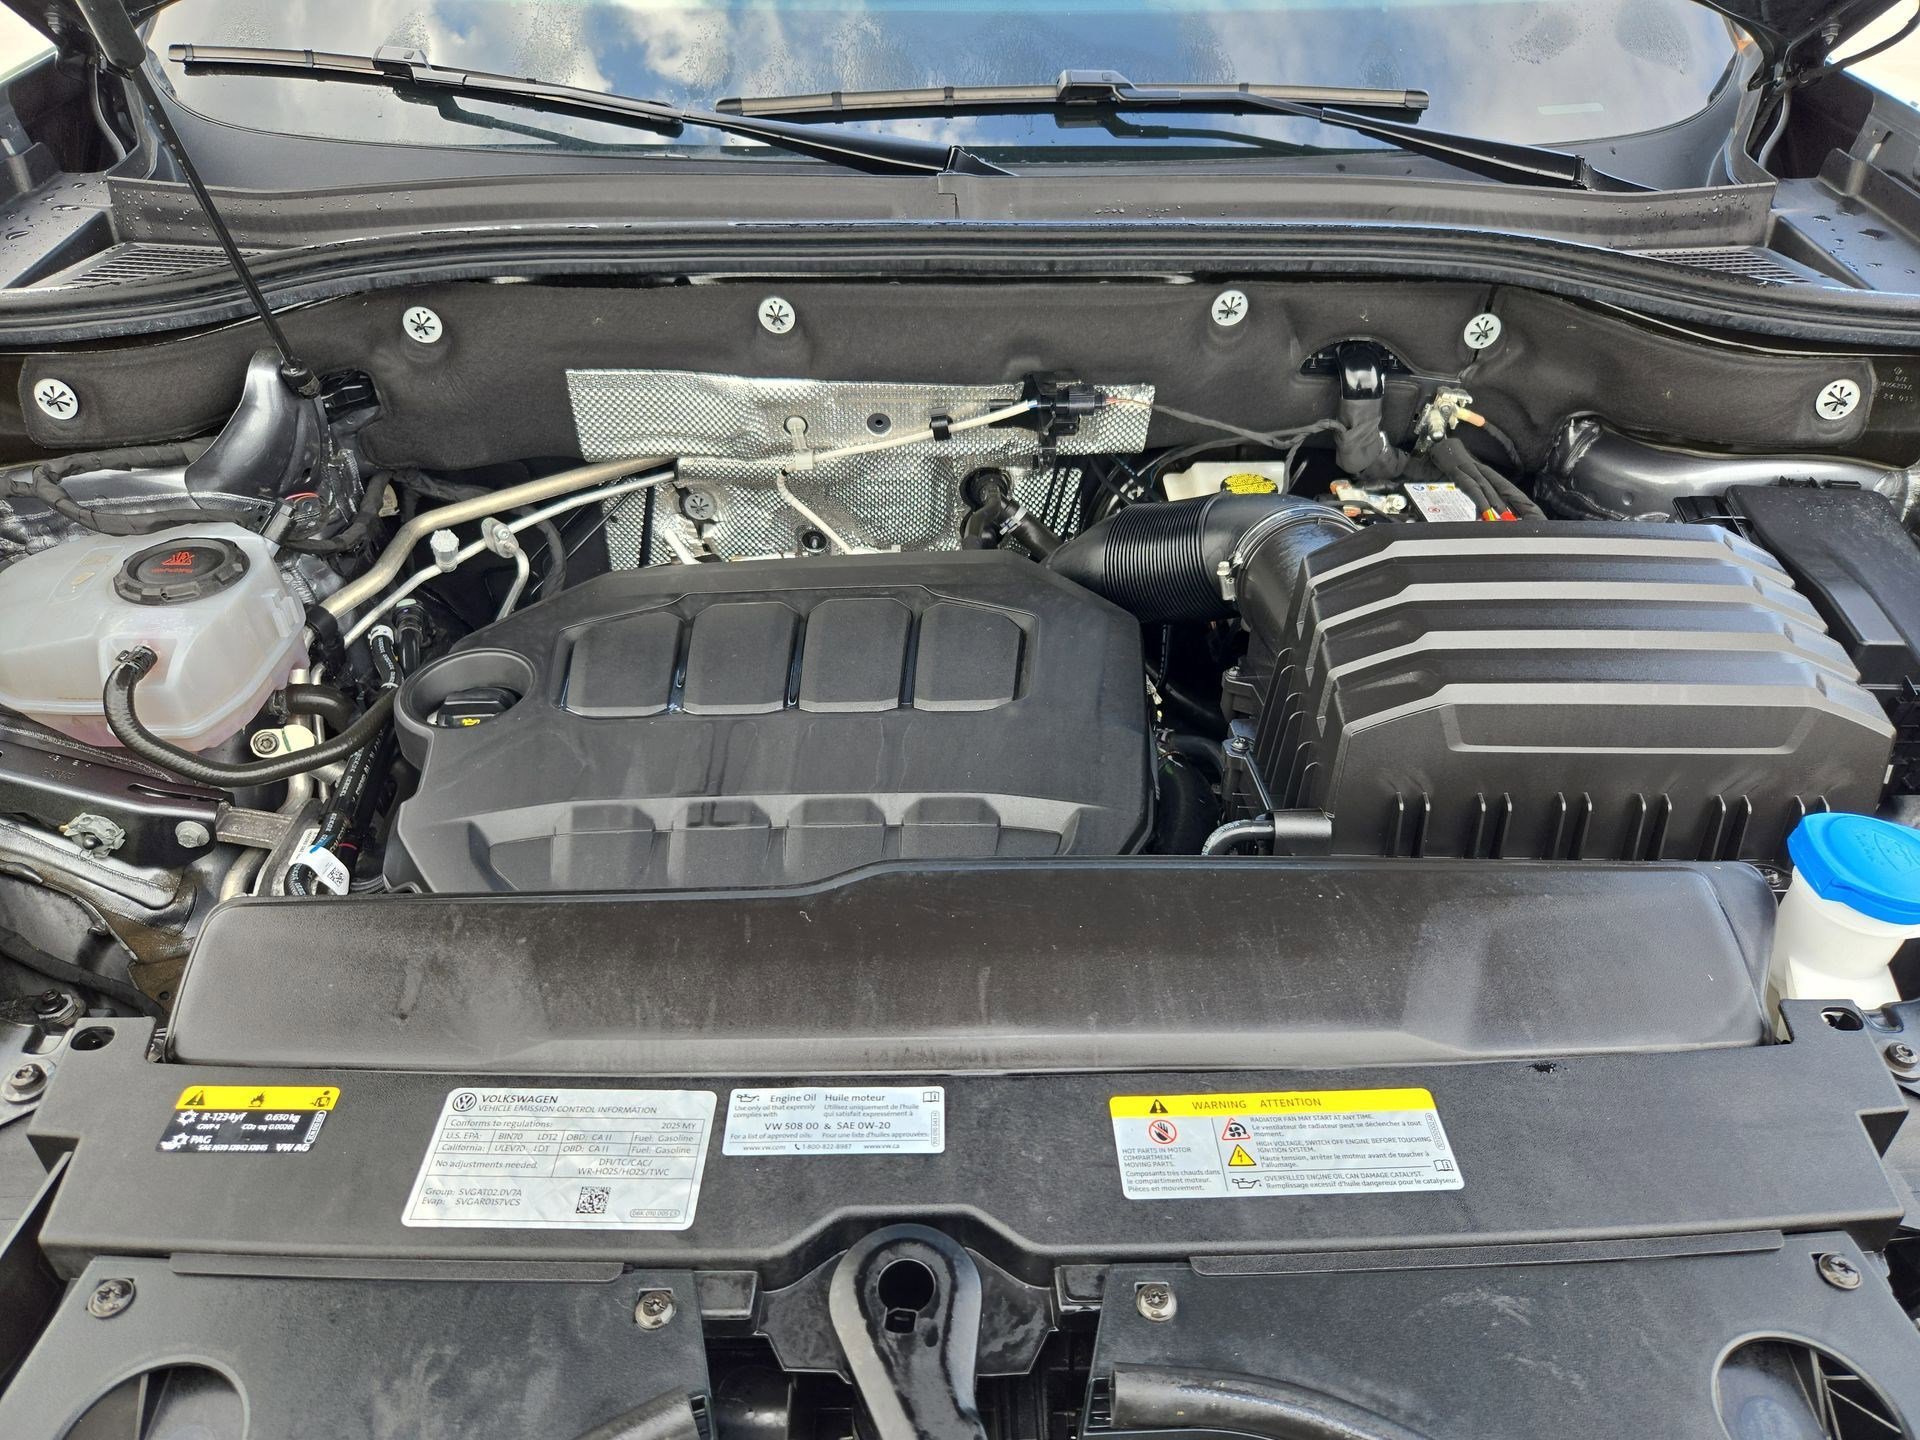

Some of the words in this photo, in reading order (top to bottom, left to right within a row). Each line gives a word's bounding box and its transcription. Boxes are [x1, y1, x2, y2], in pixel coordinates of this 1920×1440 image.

[482, 1094, 558, 1104] VOLKSWAGEN
[770, 1094, 801, 1104] Engine
[804, 1093, 817, 1101] Oil
[825, 1094, 850, 1102] Huile
[851, 1094, 886, 1102] moteur
[786, 1104, 816, 1112] expressly
[1192, 1099, 1247, 1110] WARNING
[1260, 1098, 1322, 1108] ATTENTION
[478, 1104, 511, 1112] VEHICLE
[513, 1104, 555, 1112] EMISSION
[556, 1105, 596, 1113] CONTROL
[597, 1105, 658, 1114] INFORMATION
[201, 1112, 248, 1123] R-1234yf
[289, 1113, 301, 1123] kg
[733, 1111, 762, 1119] complies
[451, 1120, 490, 1128] Conforms
[503, 1120, 553, 1129] regulations:
[661, 1122, 681, 1130] 2025
[682, 1122, 697, 1130] MY
[764, 1122, 783, 1131] VW
[784, 1122, 803, 1130] 508
[805, 1122, 819, 1130] 00
[836, 1122, 856, 1130] SAE
[857, 1121, 892, 1130] 0W-20
[189, 1135, 213, 1144] PAG
[446, 1132, 462, 1140] U.S.
[498, 1132, 524, 1140] BIN70
[537, 1133, 558, 1141] LDT2
[566, 1133, 588, 1141] OBD:
[634, 1134, 653, 1142] Fuel:
[657, 1134, 694, 1142] Gasoline
[767, 1133, 799, 1141] approved
[276, 1143, 294, 1152] VW
[293, 1143, 310, 1152] AG
[441, 1143, 486, 1152] California:
[494, 1144, 526, 1152] ULEV70
[533, 1145, 550, 1153] LDT
[562, 1145, 584, 1153] OBD:
[588, 1145, 601, 1153] CA
[631, 1146, 651, 1154] Fuel:
[655, 1146, 692, 1154] Gasoline
[435, 1160, 448, 1168] No
[449, 1160, 503, 1169] adjustments
[505, 1161, 538, 1169] needed.
[1266, 1182, 1309, 1190] Remplissage
[1361, 1180, 1397, 1188] dangereux
[1422, 1178, 1459, 1186] catalyseur.
[425, 1187, 455, 1197] Group:
[421, 1197, 445, 1207] Evap:
